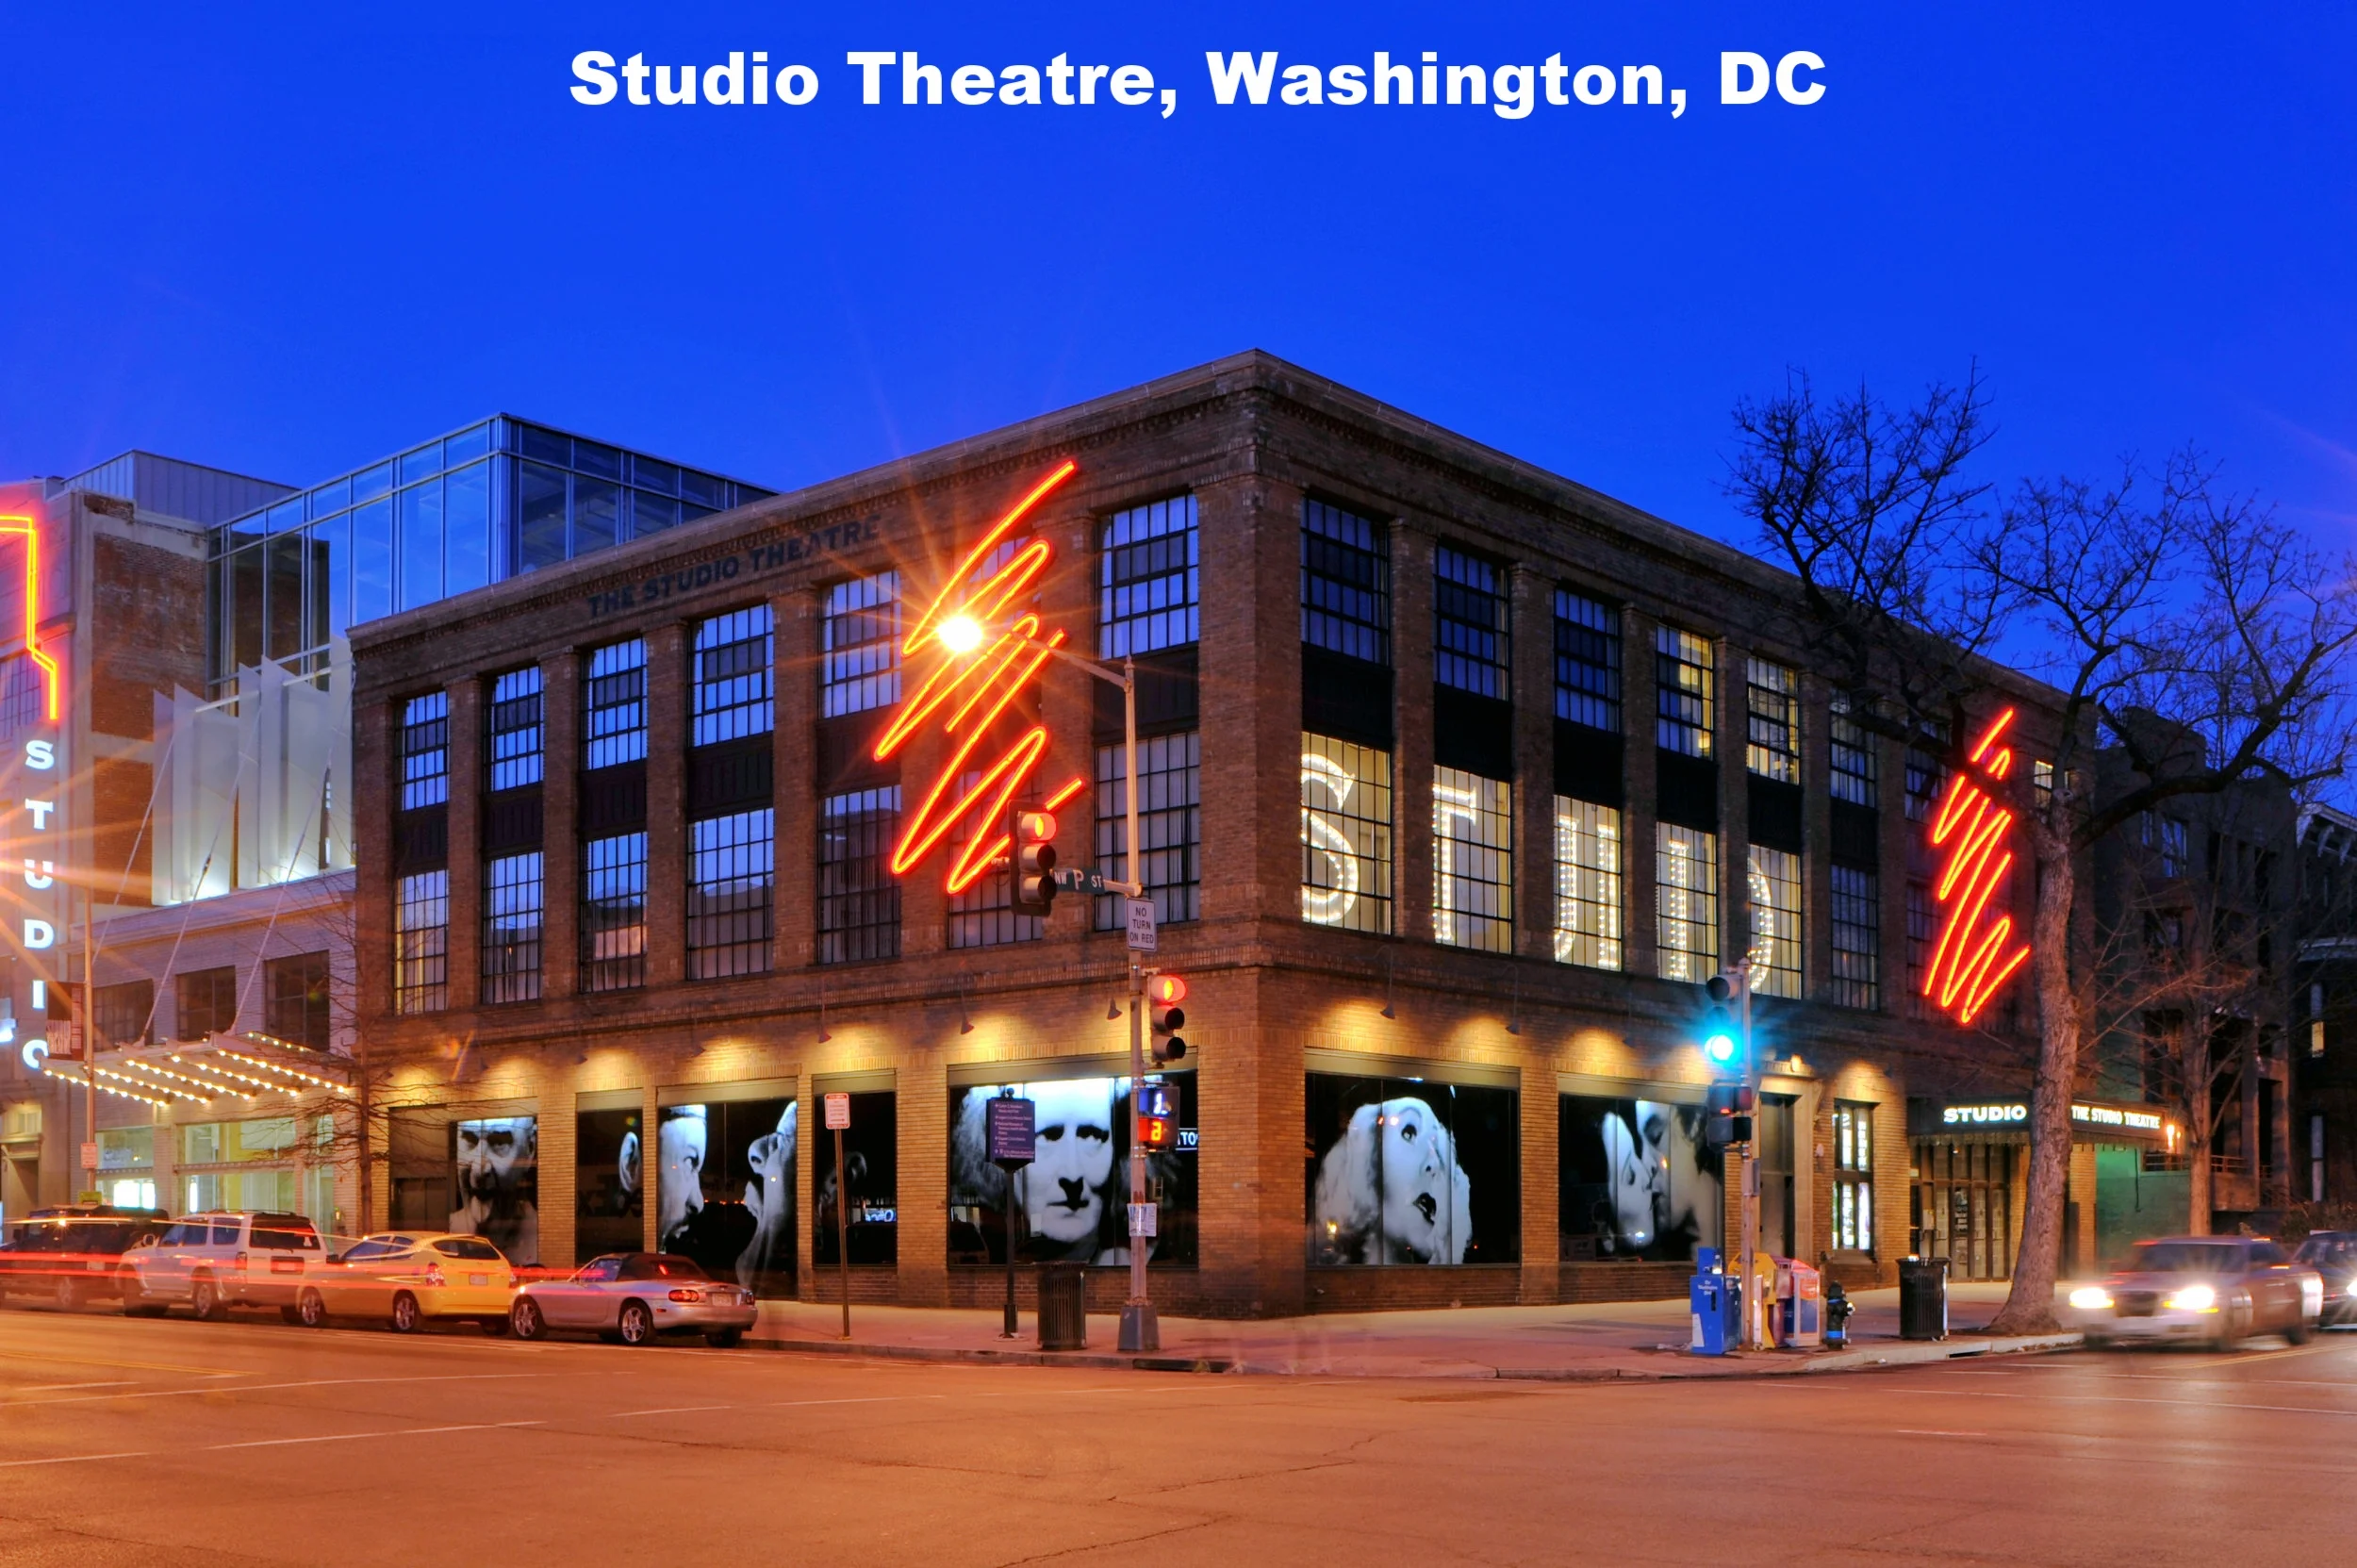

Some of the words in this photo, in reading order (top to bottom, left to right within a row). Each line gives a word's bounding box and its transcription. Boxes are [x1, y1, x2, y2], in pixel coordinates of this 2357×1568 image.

[586, 583, 636, 618] THE
[643, 554, 740, 602] STUDIO
[750, 514, 882, 572] THEATRE
[1054, 871, 1067, 884] NW
[1073, 869, 1084, 890] P
[1091, 875, 1102, 888] ST
[1135, 906, 1147, 917] NO
[1132, 918, 1151, 931] TURN
[1129, 932, 1139, 942] ON
[1141, 933, 1154, 944] RED
[1943, 1104, 2027, 1124] STUDIO
[2071, 1105, 2089, 1121] THE
[2091, 1108, 2123, 1125] STUDIO
[2123, 1112, 2161, 1130] THEATRE
